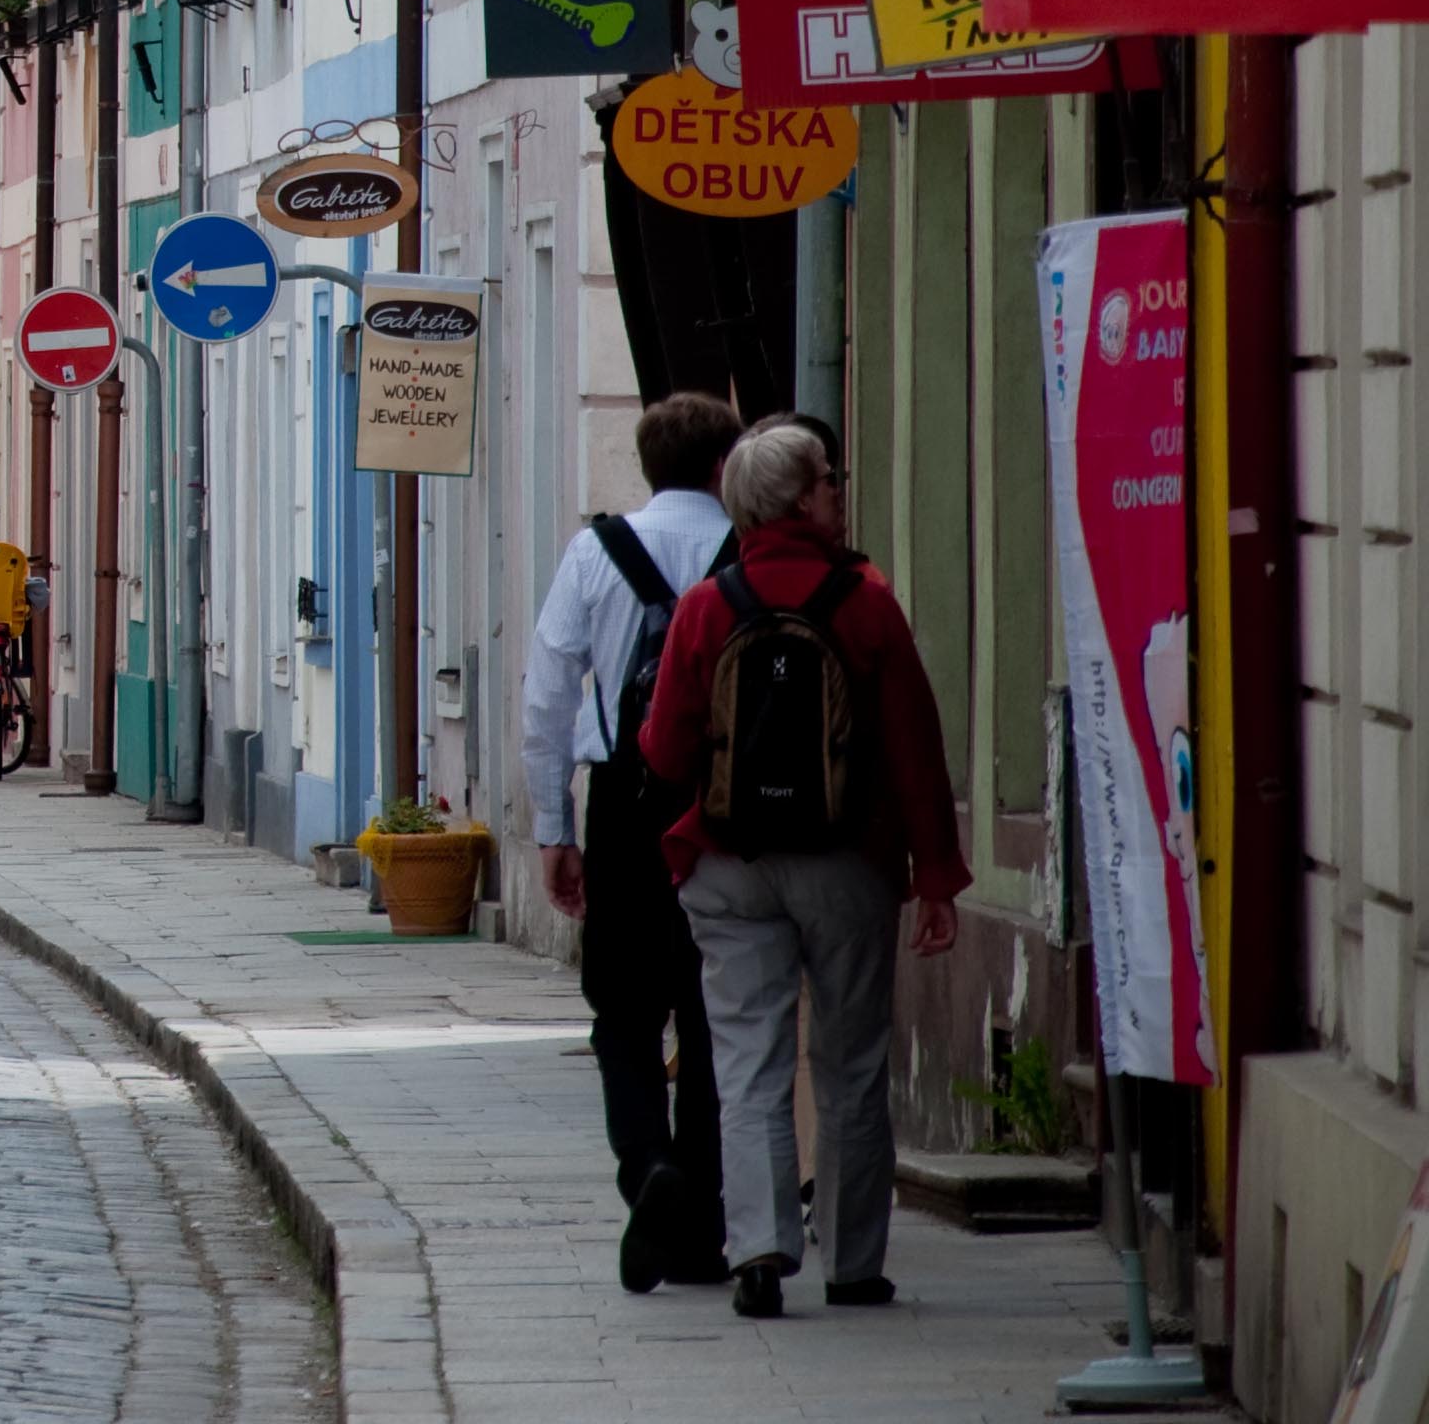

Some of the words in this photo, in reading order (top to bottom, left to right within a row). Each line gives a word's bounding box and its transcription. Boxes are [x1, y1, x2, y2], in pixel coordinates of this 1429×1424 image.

[634, 100, 835, 148] DĚTSKÁ
[290, 182, 390, 210] Gabréta
[662, 162, 805, 202] OBUV
[1139, 280, 1186, 311] YOUR
[371, 306, 471, 331] Gabréta
[1136, 328, 1186, 361] BABY
[370, 357, 464, 378] HAND-MADE
[383, 384, 446, 402] WOODEN
[1173, 378, 1184, 406] IS
[369, 408, 458, 428] JEWELLERY
[760, 787, 793, 798] TIGHT
